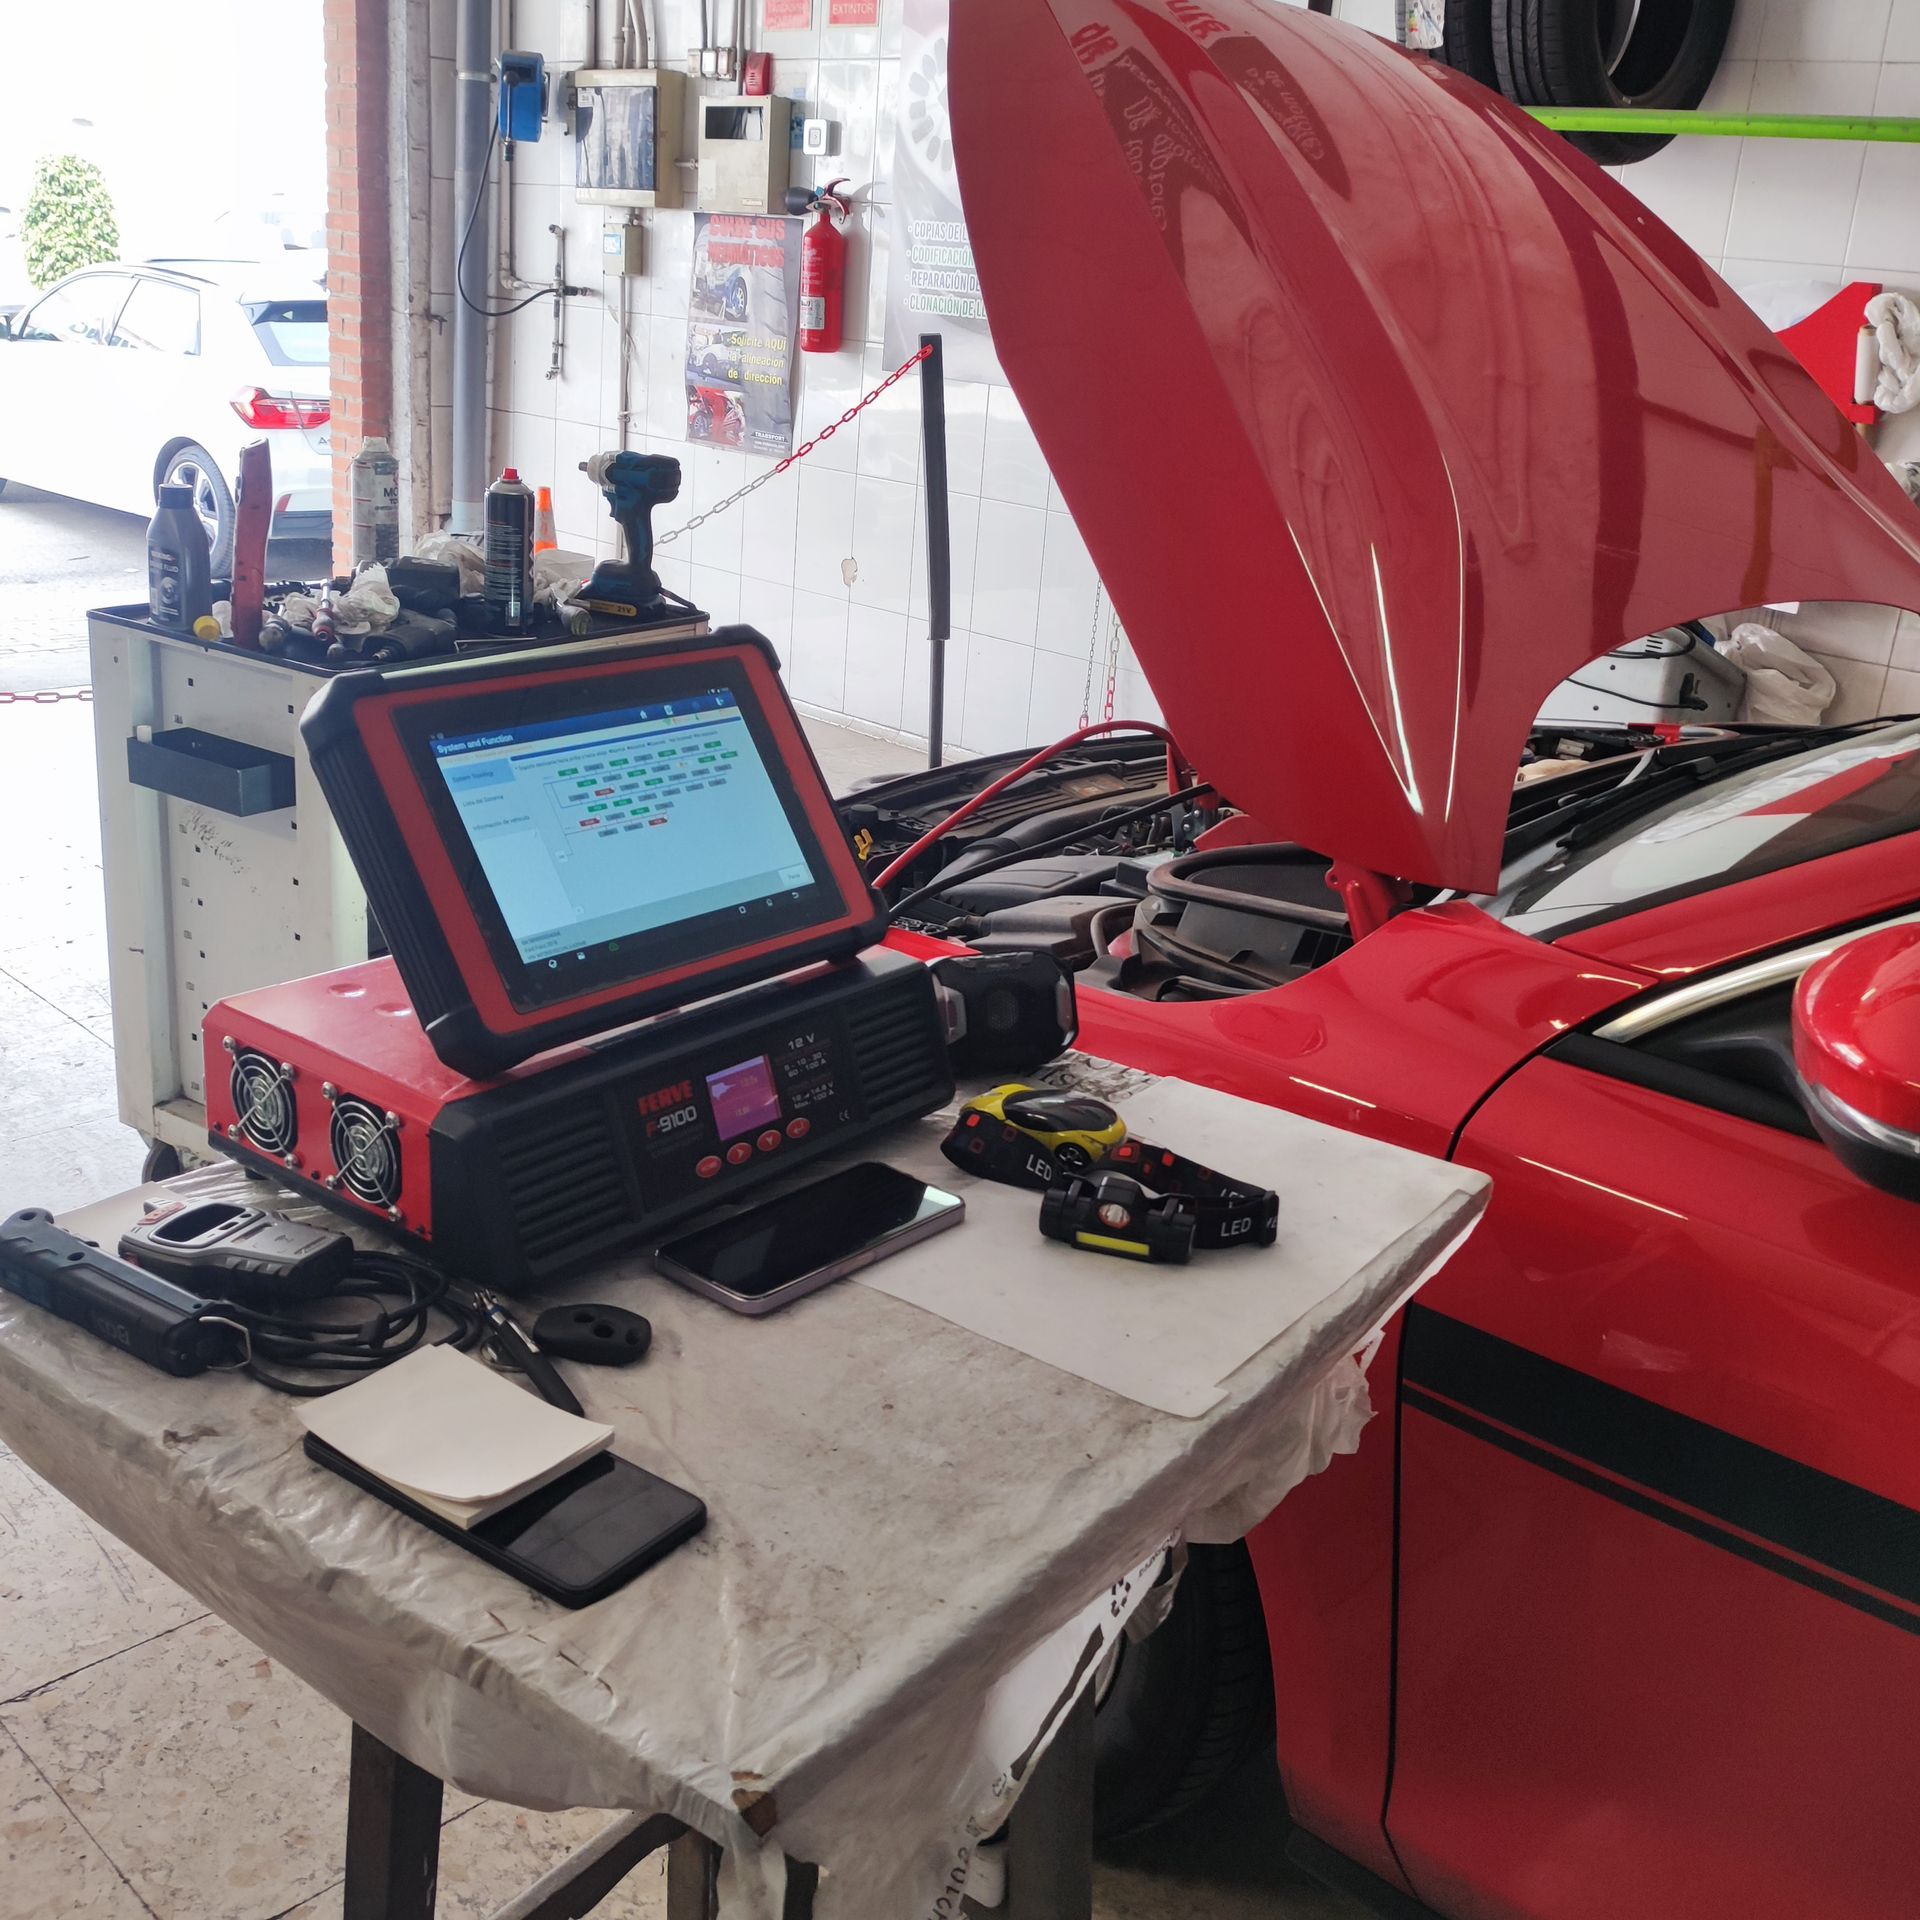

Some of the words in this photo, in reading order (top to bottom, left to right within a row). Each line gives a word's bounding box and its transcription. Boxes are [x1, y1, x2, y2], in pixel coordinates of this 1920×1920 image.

[832, 3, 874, 16] EXTINTOR
[756, 218, 785, 241] SUS
[914, 222, 946, 240] COPIAS
[948, 224, 960, 240] DE
[911, 270, 967, 291] REPARACIÓN
[910, 294, 960, 315] CLONACIÓN
[962, 299, 975, 316] DE
[731, 333, 763, 348] Solicite
[728, 367, 739, 380] de
[744, 370, 784, 386] dirección
[436, 741, 466, 757] System
[483, 732, 514, 747] Function
[805, 1033, 815, 1043] V
[1026, 1154, 1052, 1181] LED
[1220, 1217, 1252, 1237] LED
